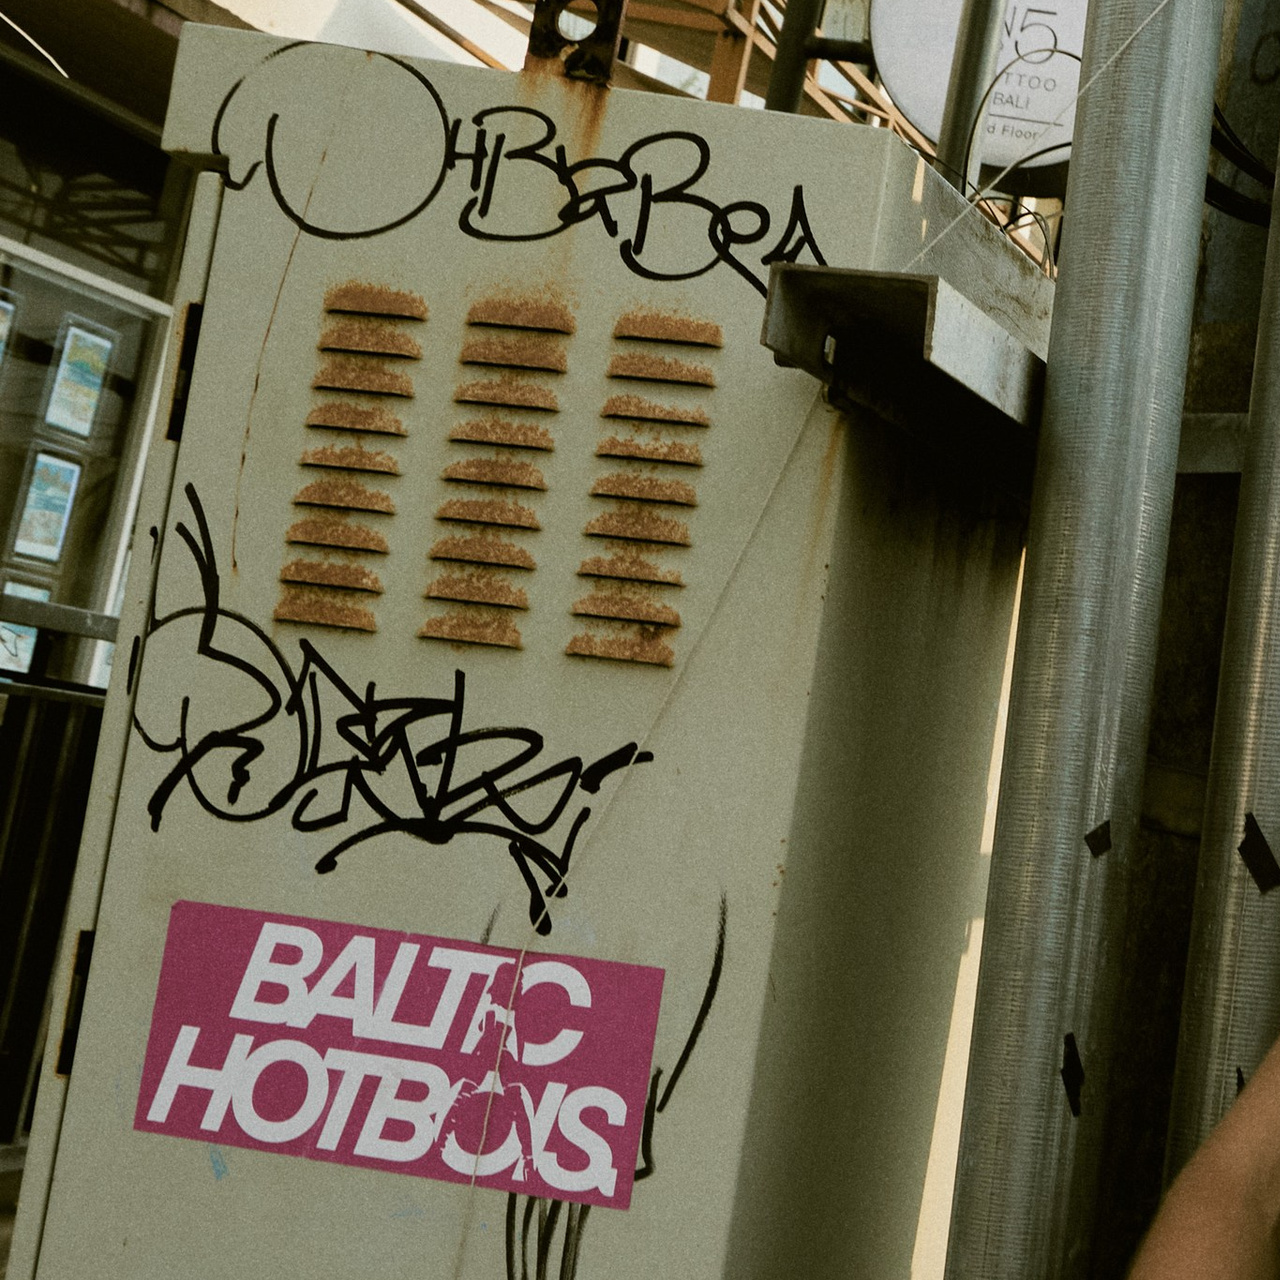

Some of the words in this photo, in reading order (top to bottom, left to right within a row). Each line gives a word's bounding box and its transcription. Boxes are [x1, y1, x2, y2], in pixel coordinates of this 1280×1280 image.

[1003, 71, 1058, 92] TTOO
[992, 91, 1031, 111] BALI
[1001, 125, 1041, 140] Floor
